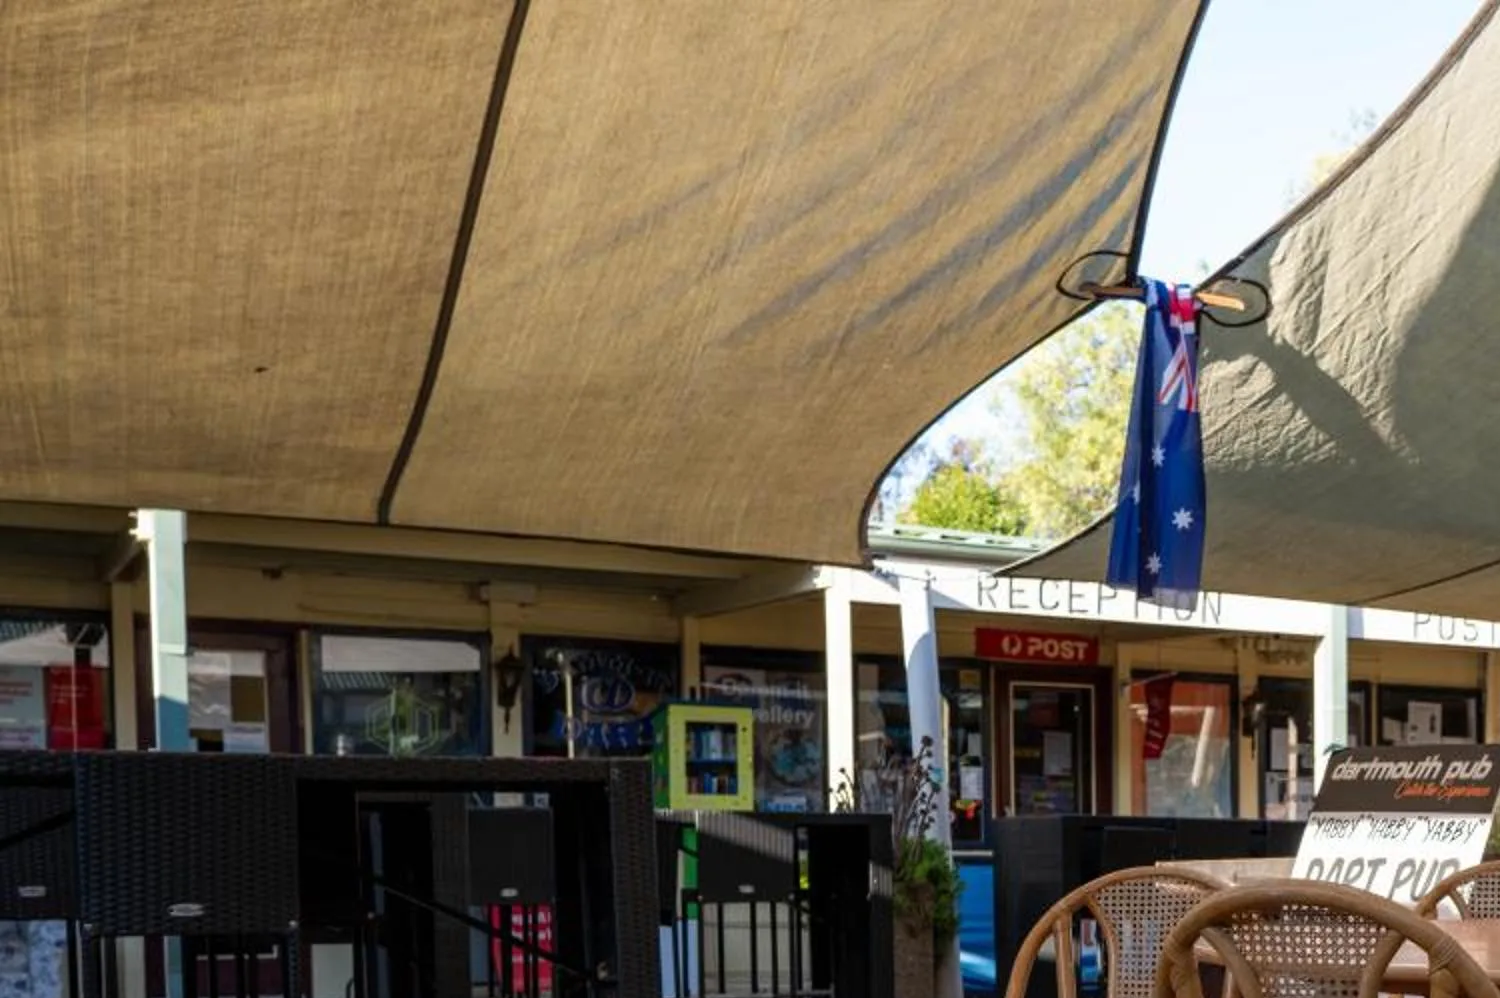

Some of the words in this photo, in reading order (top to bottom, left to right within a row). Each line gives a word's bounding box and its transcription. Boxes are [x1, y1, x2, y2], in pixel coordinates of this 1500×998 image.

[1026, 636, 1089, 662] POST
[1331, 754, 1443, 781] dartmouth
[1441, 754, 1493, 786] pub
